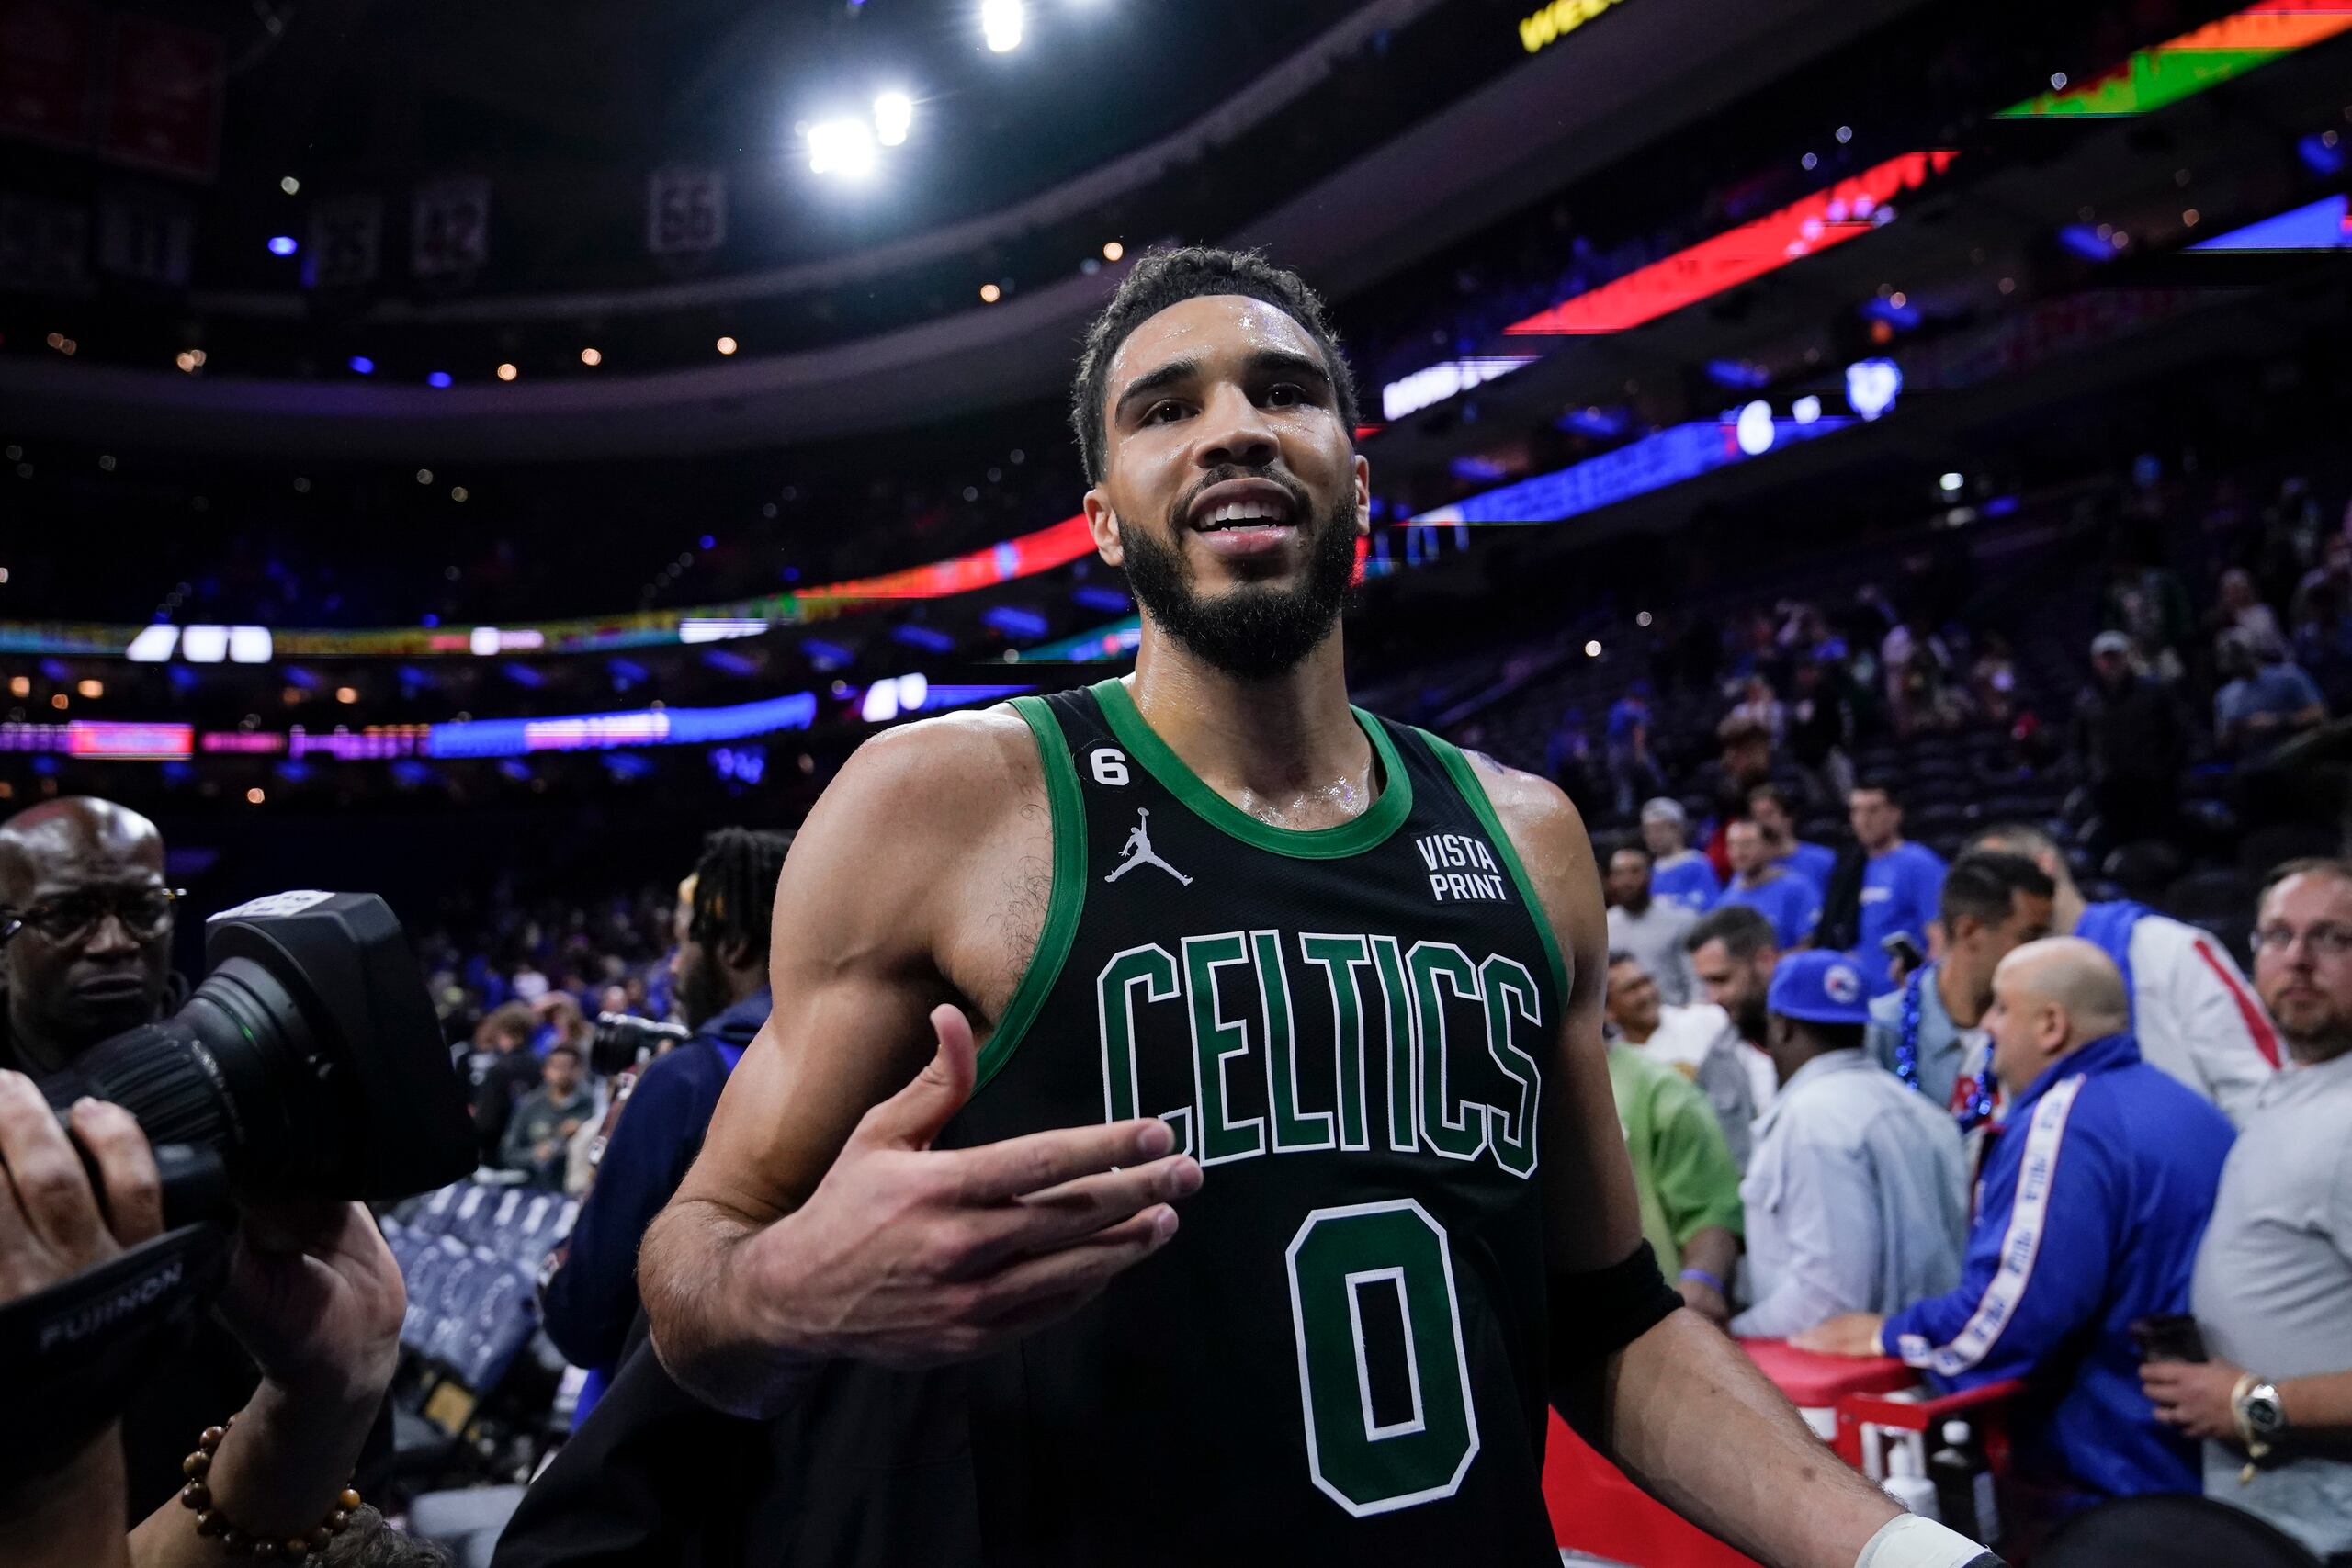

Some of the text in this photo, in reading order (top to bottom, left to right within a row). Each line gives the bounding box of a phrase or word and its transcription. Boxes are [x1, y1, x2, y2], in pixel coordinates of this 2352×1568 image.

[1089, 747, 1131, 787] 6
[1416, 832, 1501, 874] VISTA
[1429, 873, 1508, 903] PRINT
[1097, 928, 1543, 1180] CELTICS
[36, 1259, 184, 1357] FUJINON
[1285, 1197, 1482, 1519] 0
